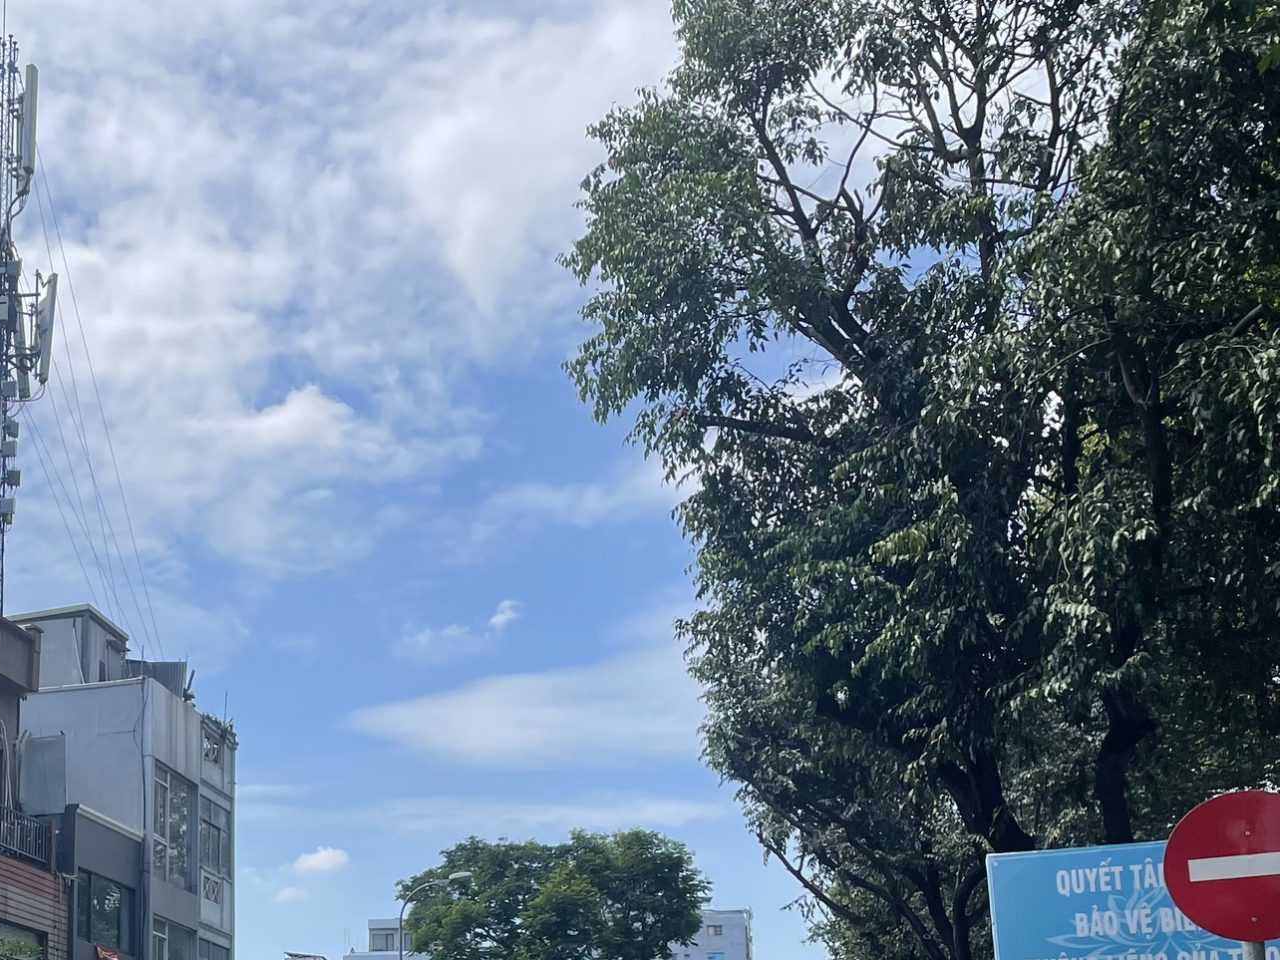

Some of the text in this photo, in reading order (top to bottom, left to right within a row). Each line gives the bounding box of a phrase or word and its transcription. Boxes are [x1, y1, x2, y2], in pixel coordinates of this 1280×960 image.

[1056, 857, 1124, 897] QUYẾT
[1075, 905, 1120, 938] BẢO
[1124, 902, 1154, 940] VỆ
